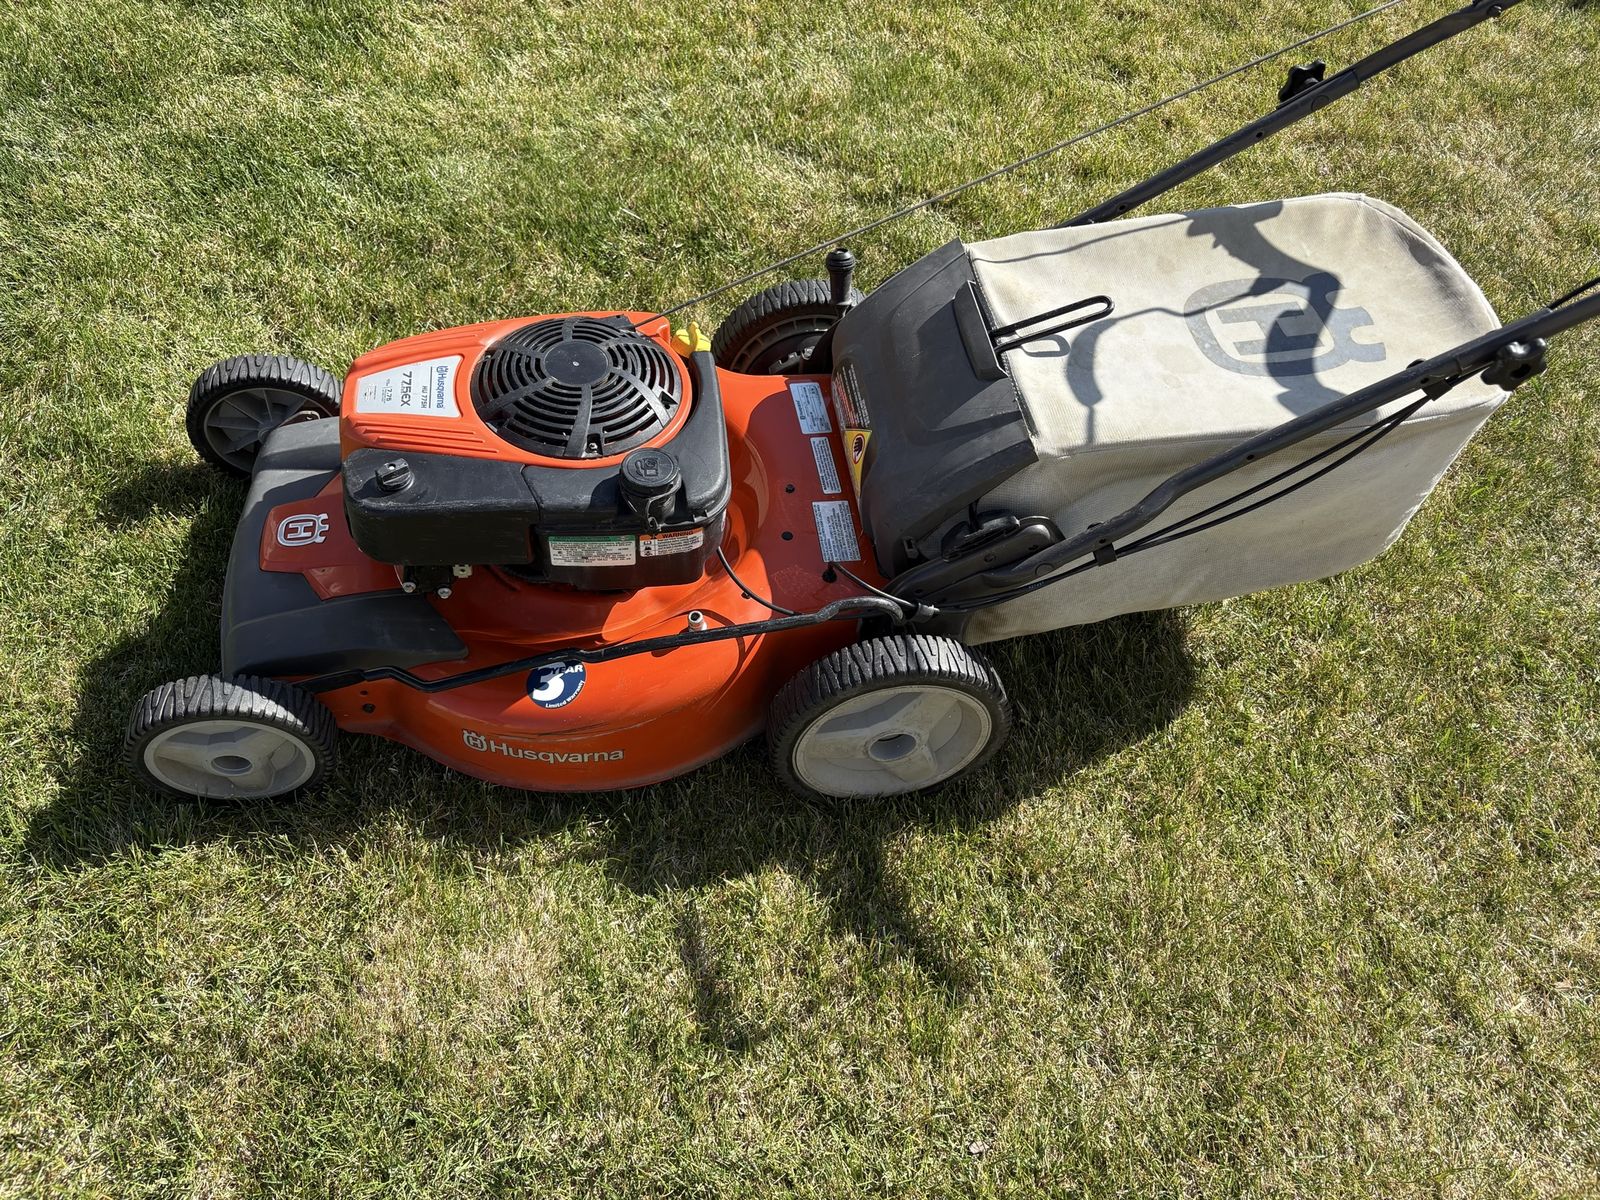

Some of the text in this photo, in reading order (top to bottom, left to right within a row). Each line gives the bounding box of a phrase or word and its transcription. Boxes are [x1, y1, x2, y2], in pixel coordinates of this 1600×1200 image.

[422, 385, 429, 394] HU
[436, 372, 447, 409] Husqvarna
[663, 530, 694, 539] WARNING
[532, 661, 584, 702] 3 YEAR
[545, 680, 586, 708] Limited Warranty
[489, 740, 625, 764] Husqvarna
